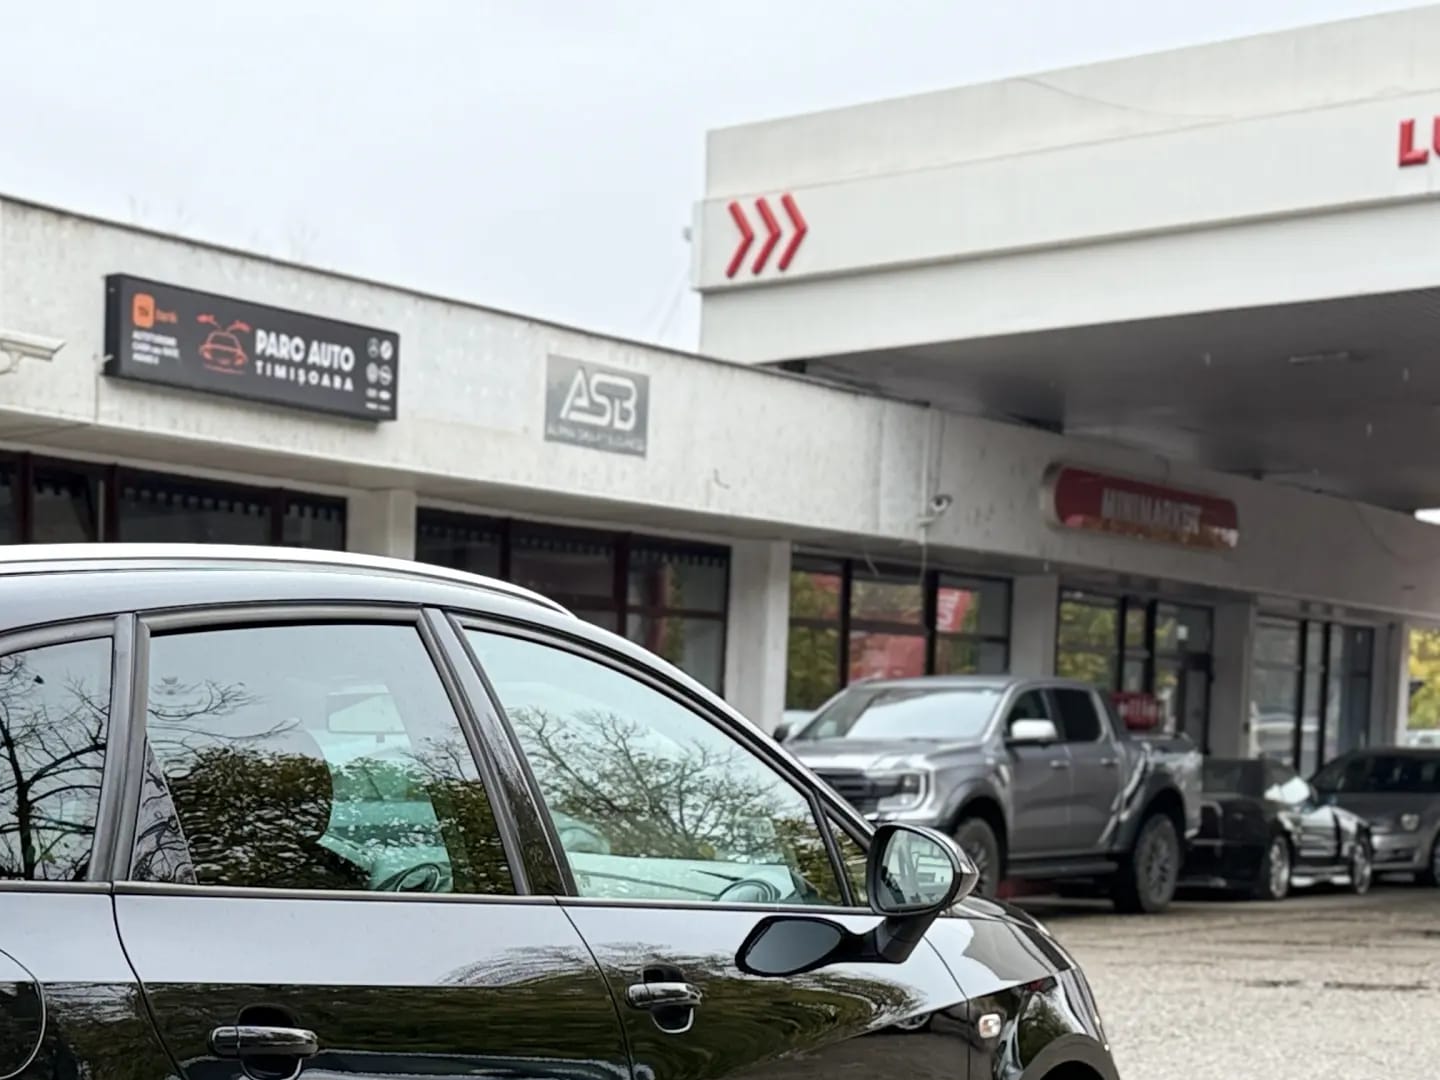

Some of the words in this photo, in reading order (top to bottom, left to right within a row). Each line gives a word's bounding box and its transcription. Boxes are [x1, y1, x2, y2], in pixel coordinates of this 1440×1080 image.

[1398, 117, 1440, 168] L
[255, 328, 306, 362] PARC
[307, 340, 356, 372] AUTO
[560, 368, 638, 431] ASB
